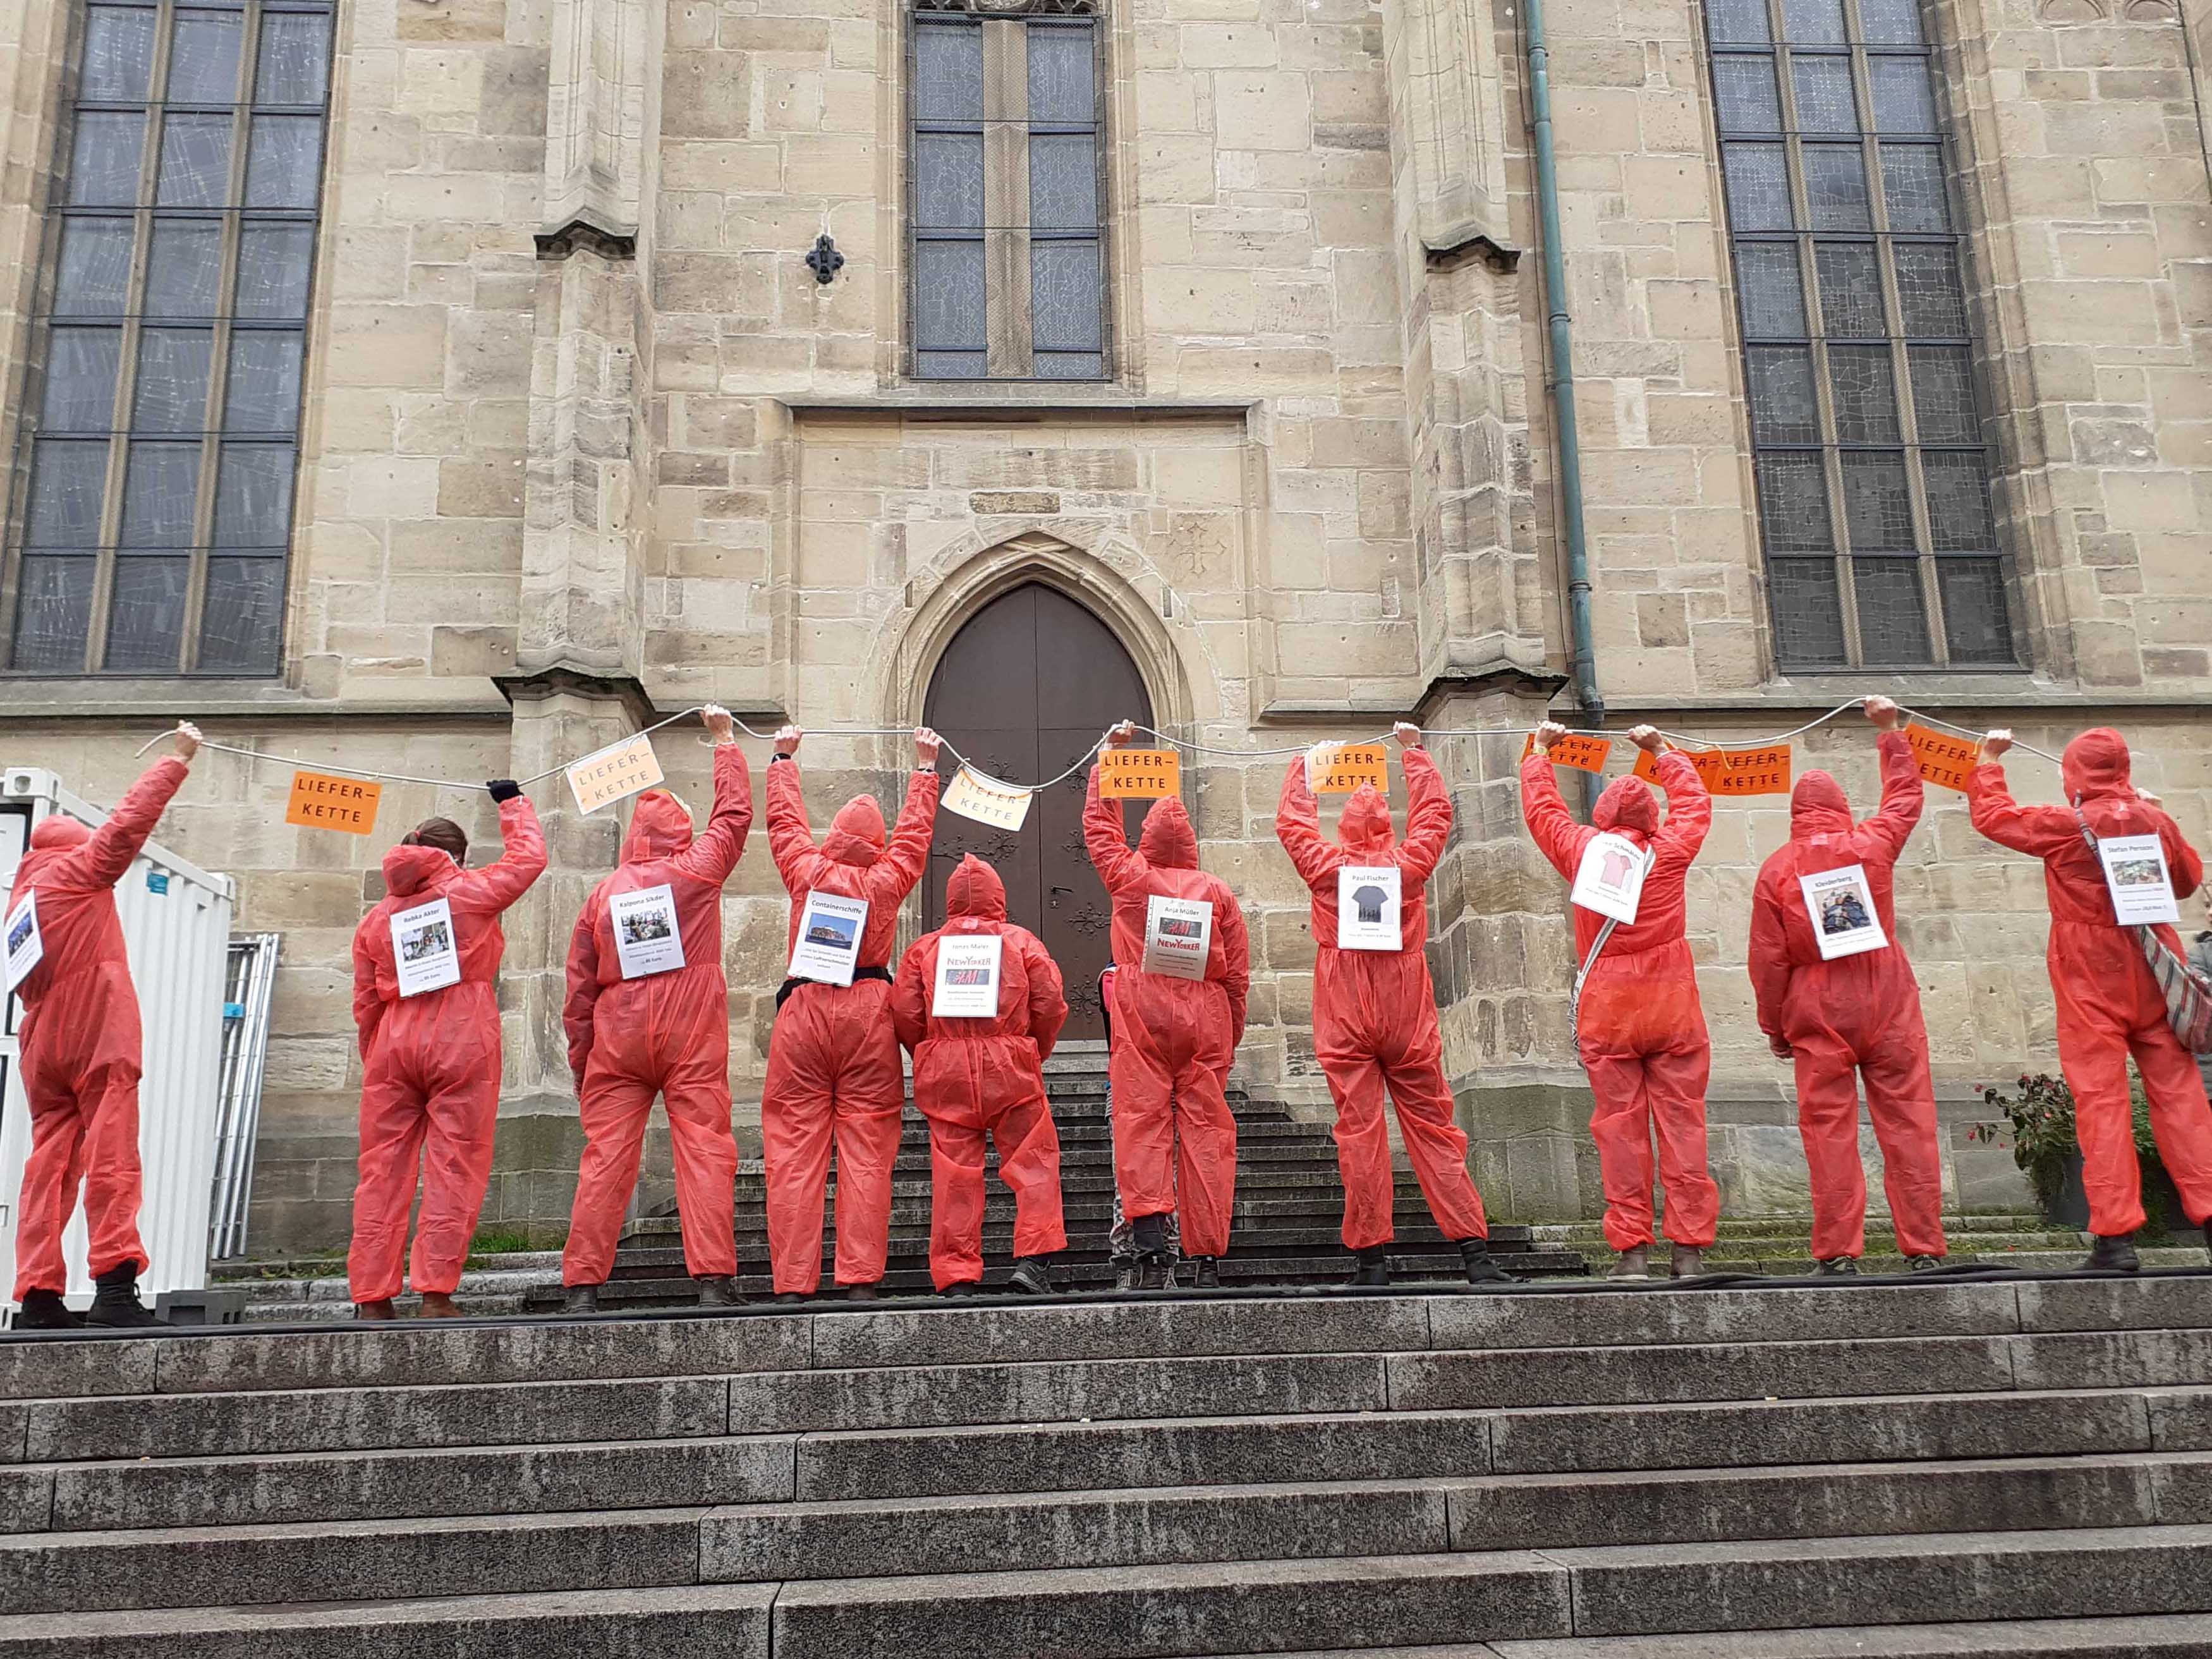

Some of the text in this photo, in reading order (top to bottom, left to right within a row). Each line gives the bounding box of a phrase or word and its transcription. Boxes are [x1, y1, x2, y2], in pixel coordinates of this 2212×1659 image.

[1908, 734, 1978, 761] LIEFER-
[578, 752, 649, 786] LIEFER-
[1105, 755, 1174, 767] LIEFER-
[1316, 753, 1385, 765] LIEFER-
[1114, 777, 1165, 788] KETTE
[1325, 775, 1378, 786] KETTE
[1723, 773, 1780, 787] KETTE
[1919, 763, 1963, 784] ETTE
[298, 778, 375, 799] LIEFER-
[594, 770, 649, 800] KETTE
[302, 803, 361, 823] KETTE
[960, 798, 1012, 820] KETTE
[811, 900, 862, 915] Containerschiffe
